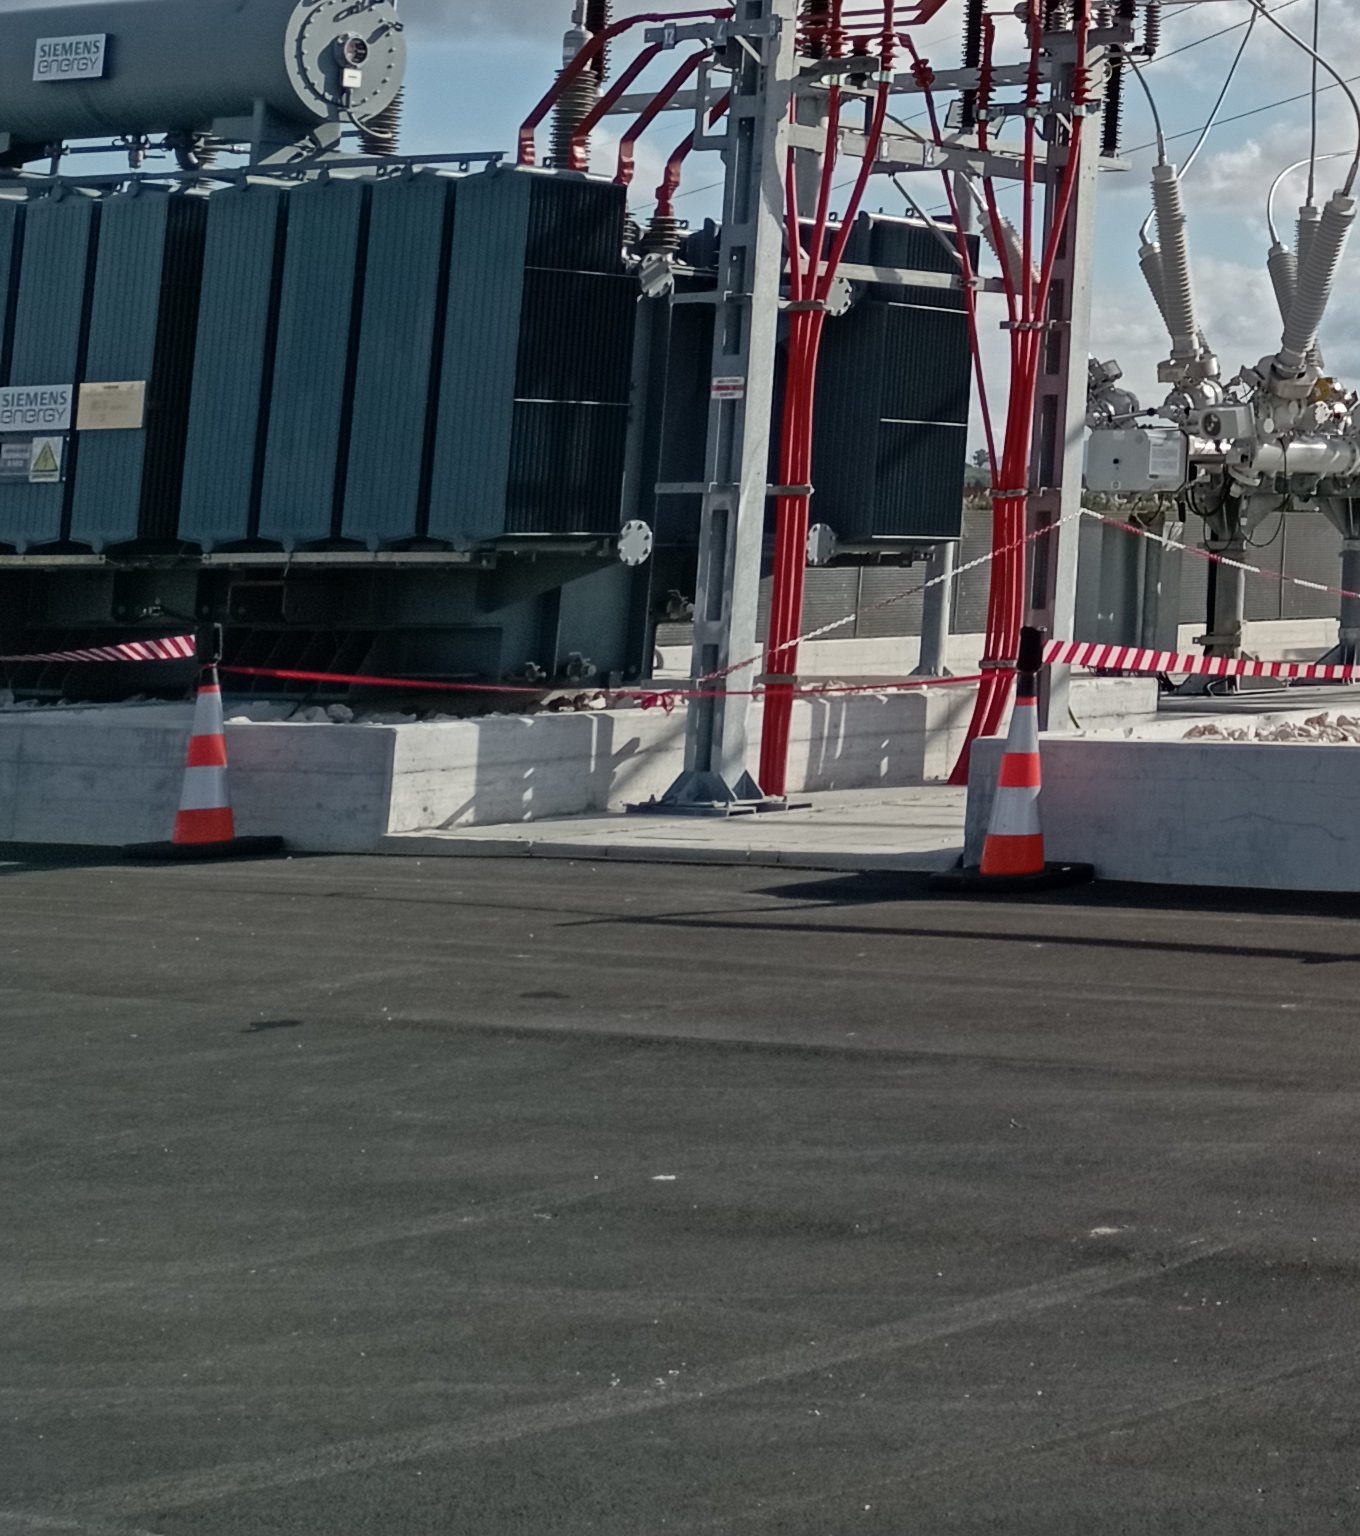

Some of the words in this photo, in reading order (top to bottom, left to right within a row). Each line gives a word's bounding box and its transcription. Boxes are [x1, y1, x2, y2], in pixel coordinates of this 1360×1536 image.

[39, 40, 101, 58] SIEMENS
[37, 56, 99, 74] energy
[2, 390, 68, 407] SIEMENS
[1, 407, 66, 424] energy
